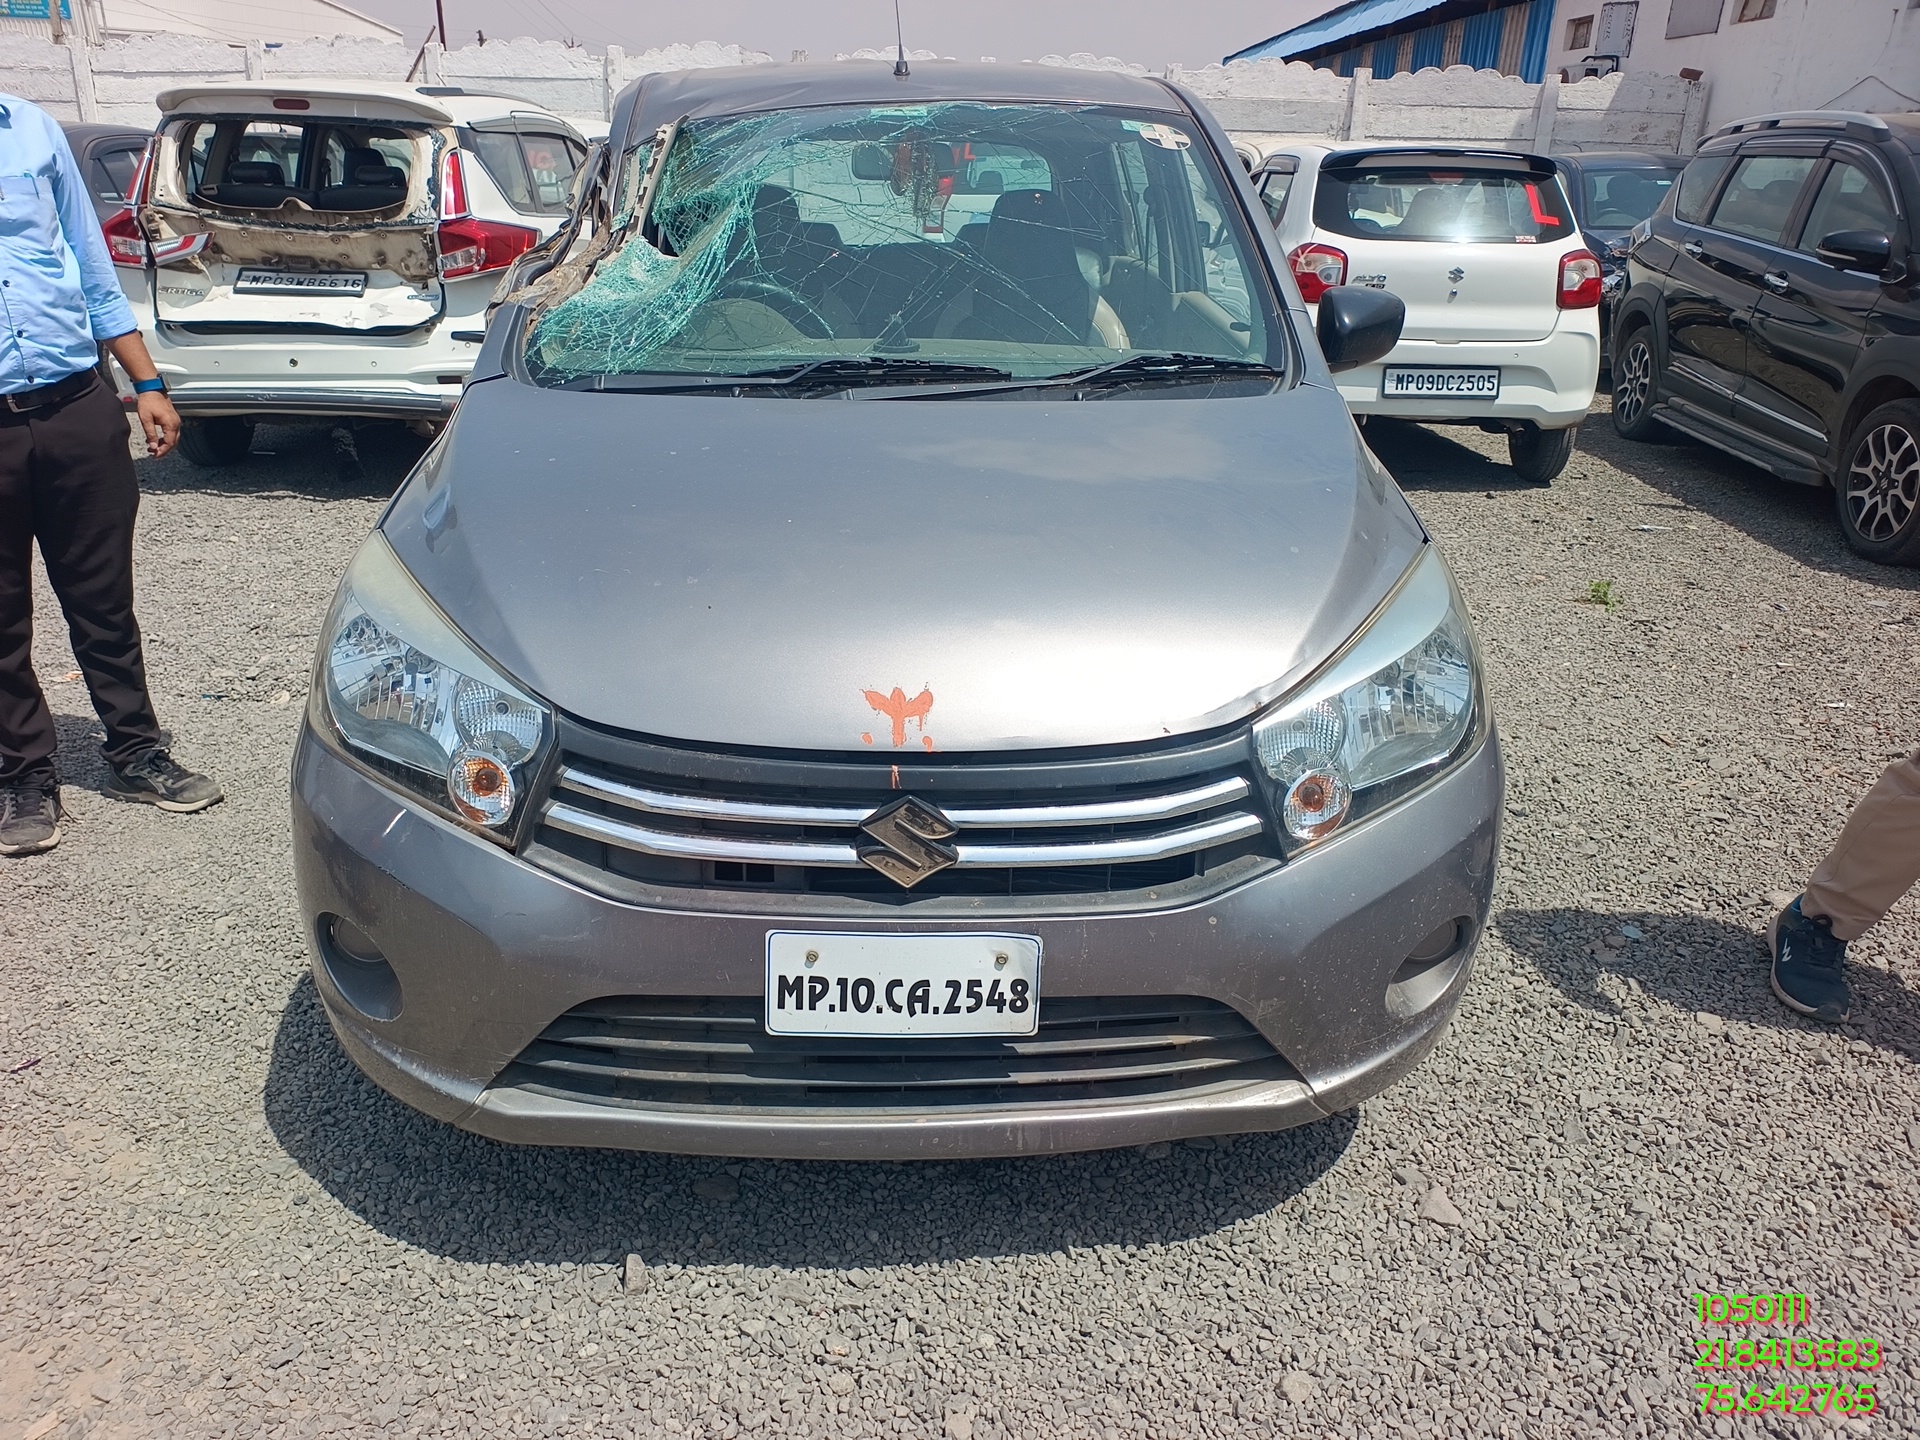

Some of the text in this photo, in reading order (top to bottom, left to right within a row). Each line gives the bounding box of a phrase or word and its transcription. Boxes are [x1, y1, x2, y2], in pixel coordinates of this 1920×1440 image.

[249, 275, 362, 289] MP09WB6616
[158, 285, 206, 296] ERTIGA
[1395, 374, 1497, 391] MP09DC2505
[777, 974, 1030, 1018] MP.10.CA.2548
